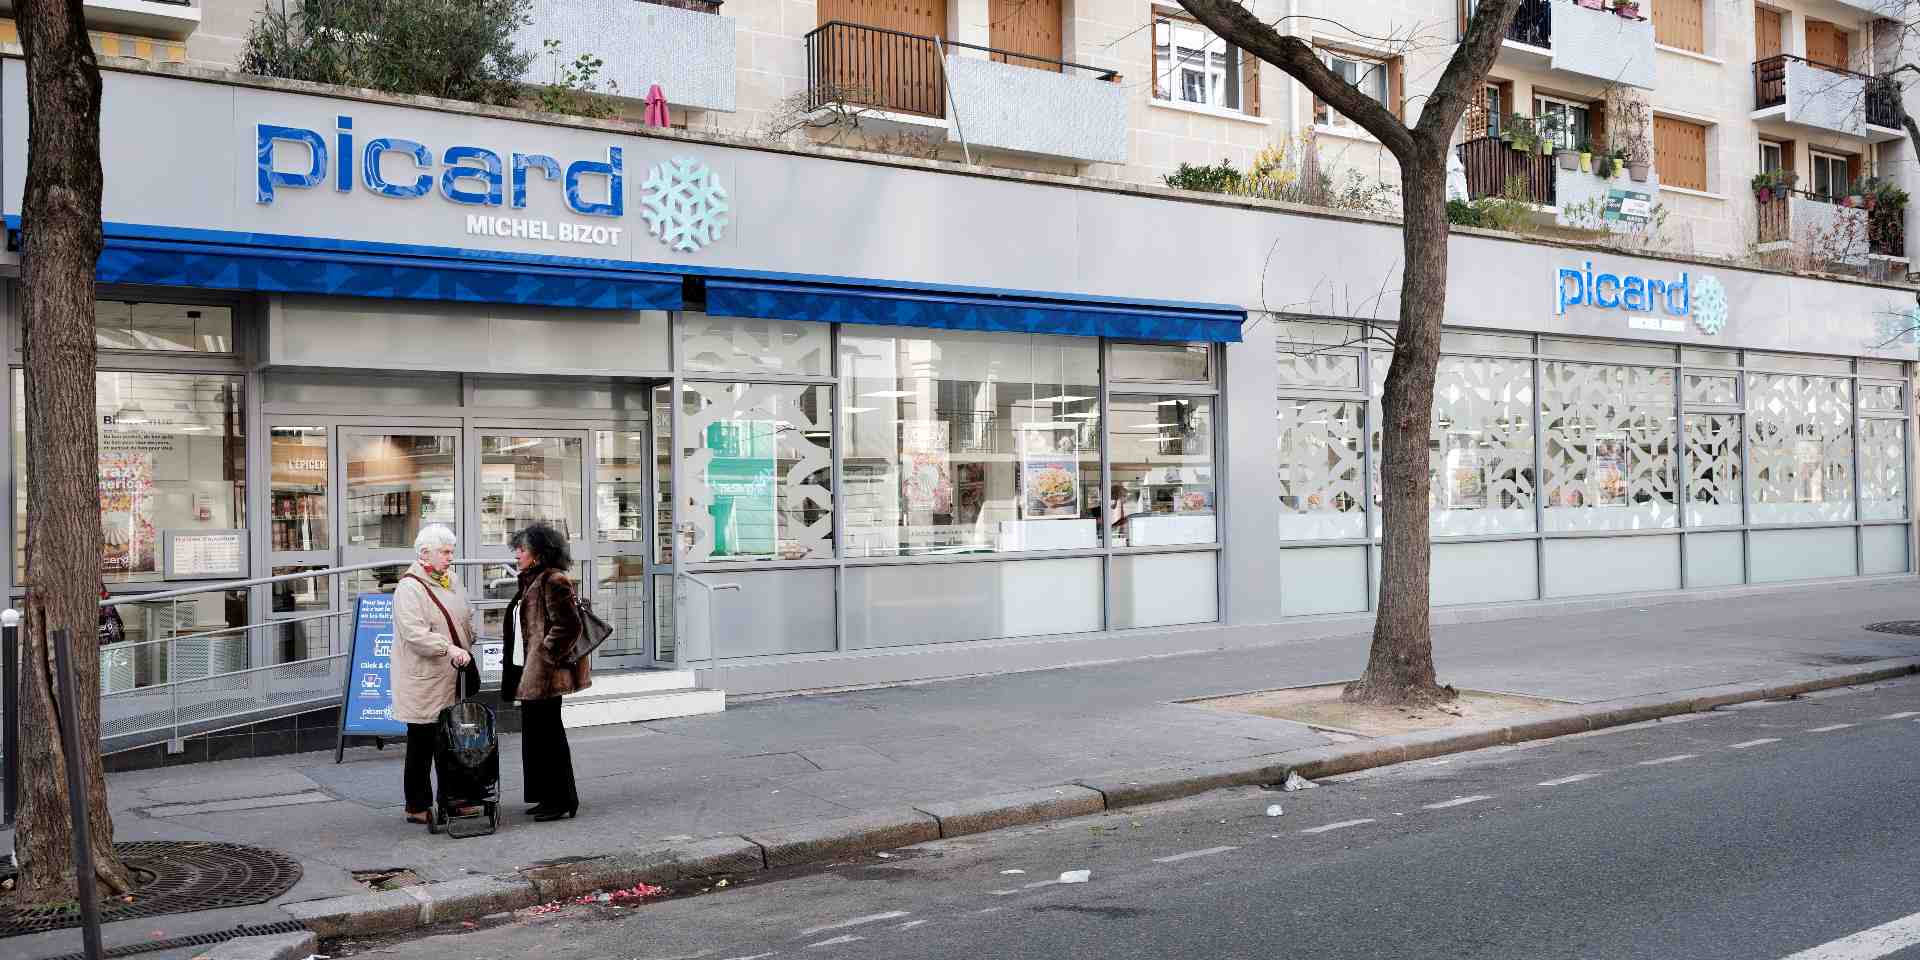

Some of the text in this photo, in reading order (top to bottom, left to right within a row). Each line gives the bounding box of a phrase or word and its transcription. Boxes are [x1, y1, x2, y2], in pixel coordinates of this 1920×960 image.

[256, 115, 624, 217] picard
[467, 214, 623, 246] MICHEL BIZOT
[1555, 261, 1689, 318] picard
